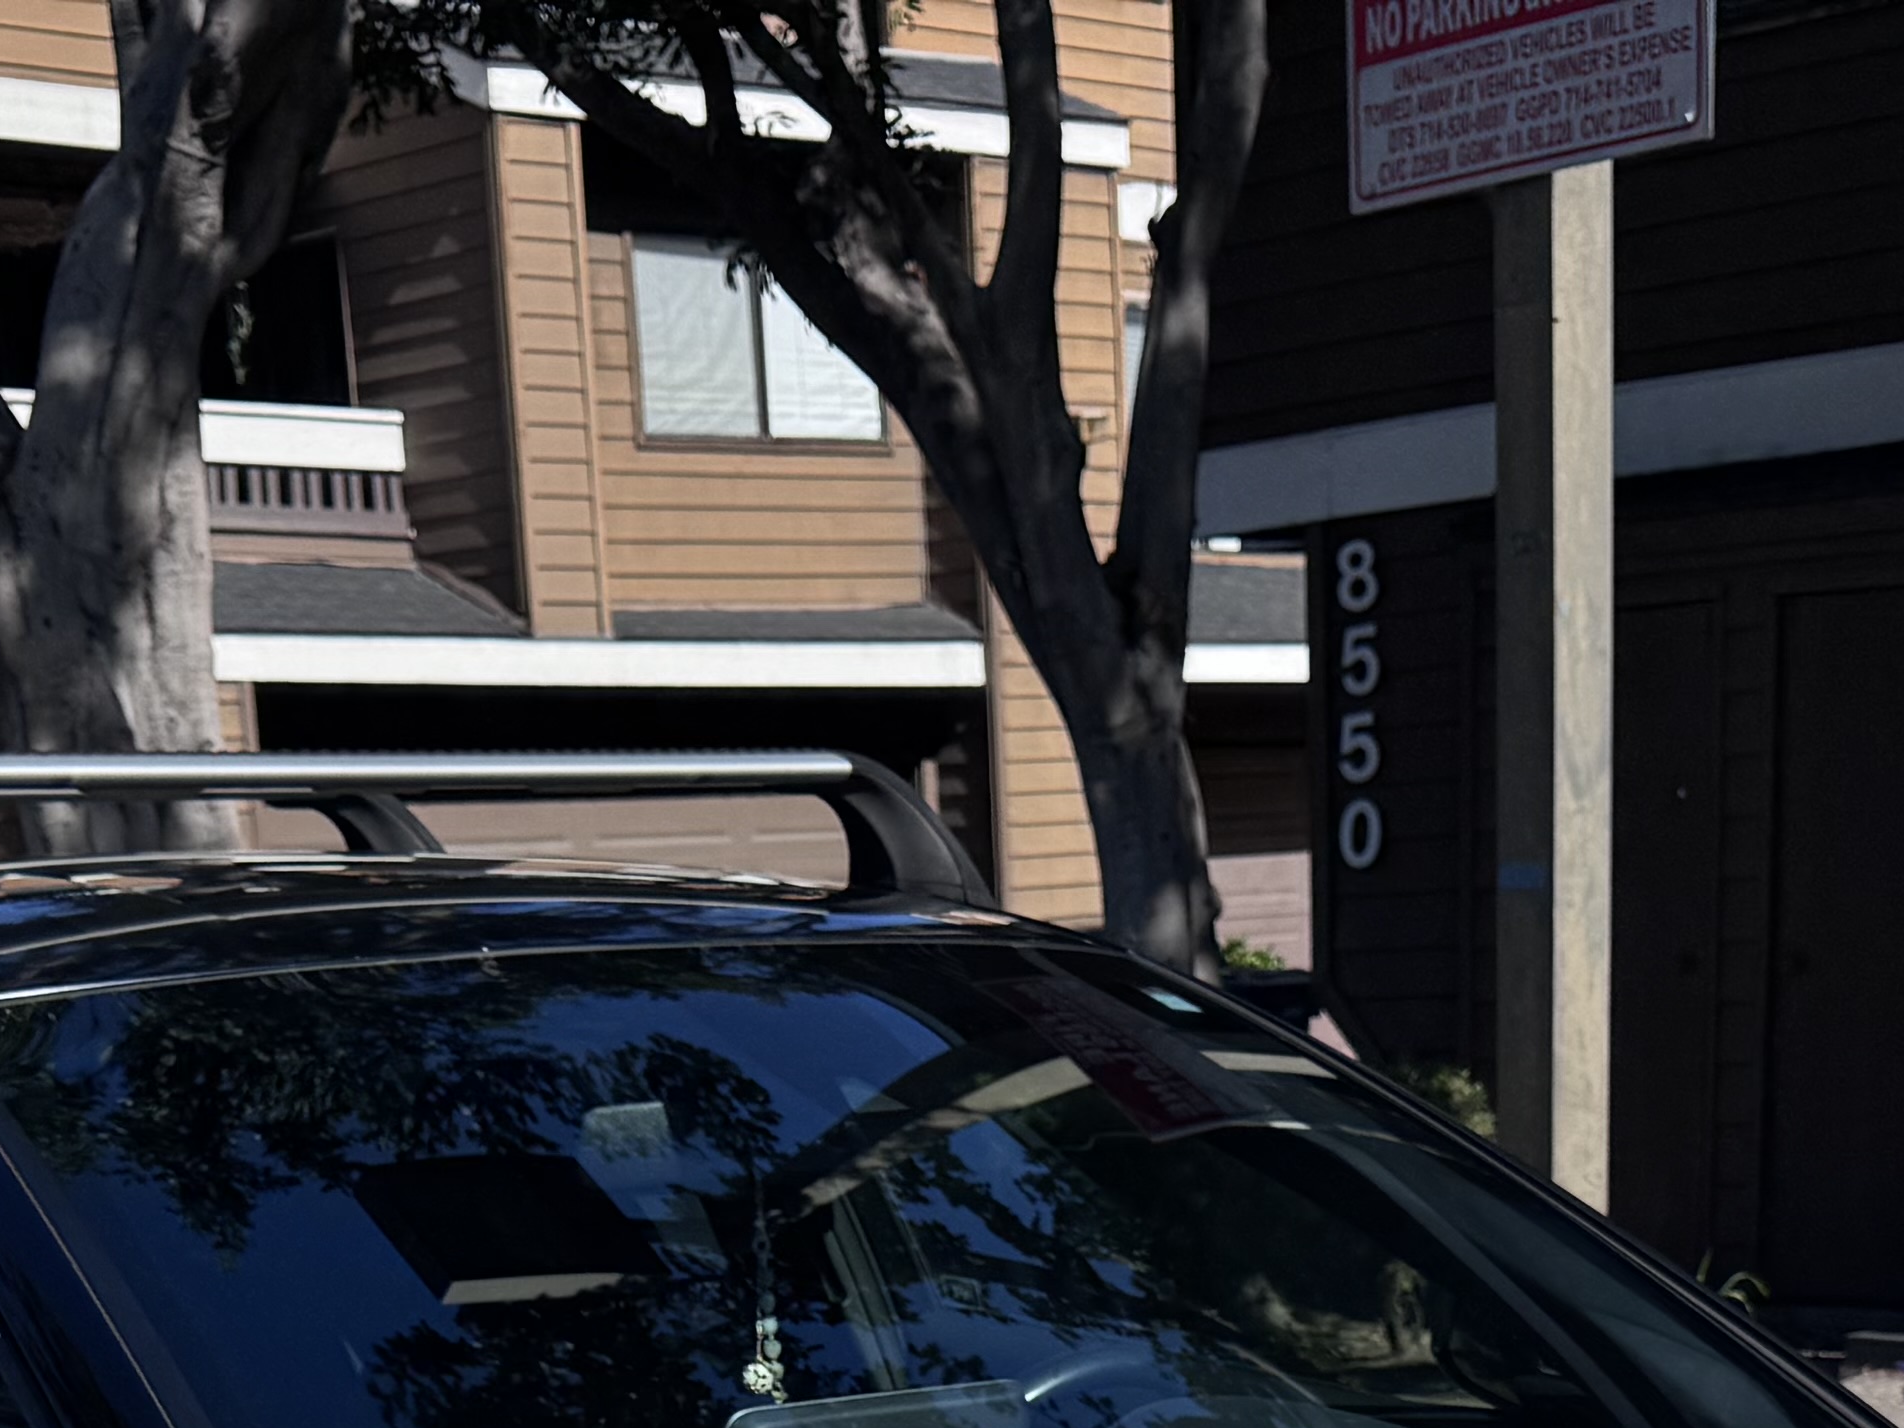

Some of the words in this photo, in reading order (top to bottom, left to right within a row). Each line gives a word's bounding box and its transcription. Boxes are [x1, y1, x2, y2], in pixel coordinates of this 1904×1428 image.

[1365, 1, 1403, 54] NO
[1509, 19, 1587, 60] VEHICLES
[1591, 9, 1629, 41] WILL
[1633, 2, 1656, 29] BE
[1478, 63, 1540, 100] VEHICLE
[1618, 26, 1692, 66] EXPENSE
[1580, 110, 1612, 139] CVC
[1336, 538, 1383, 869] 8550
